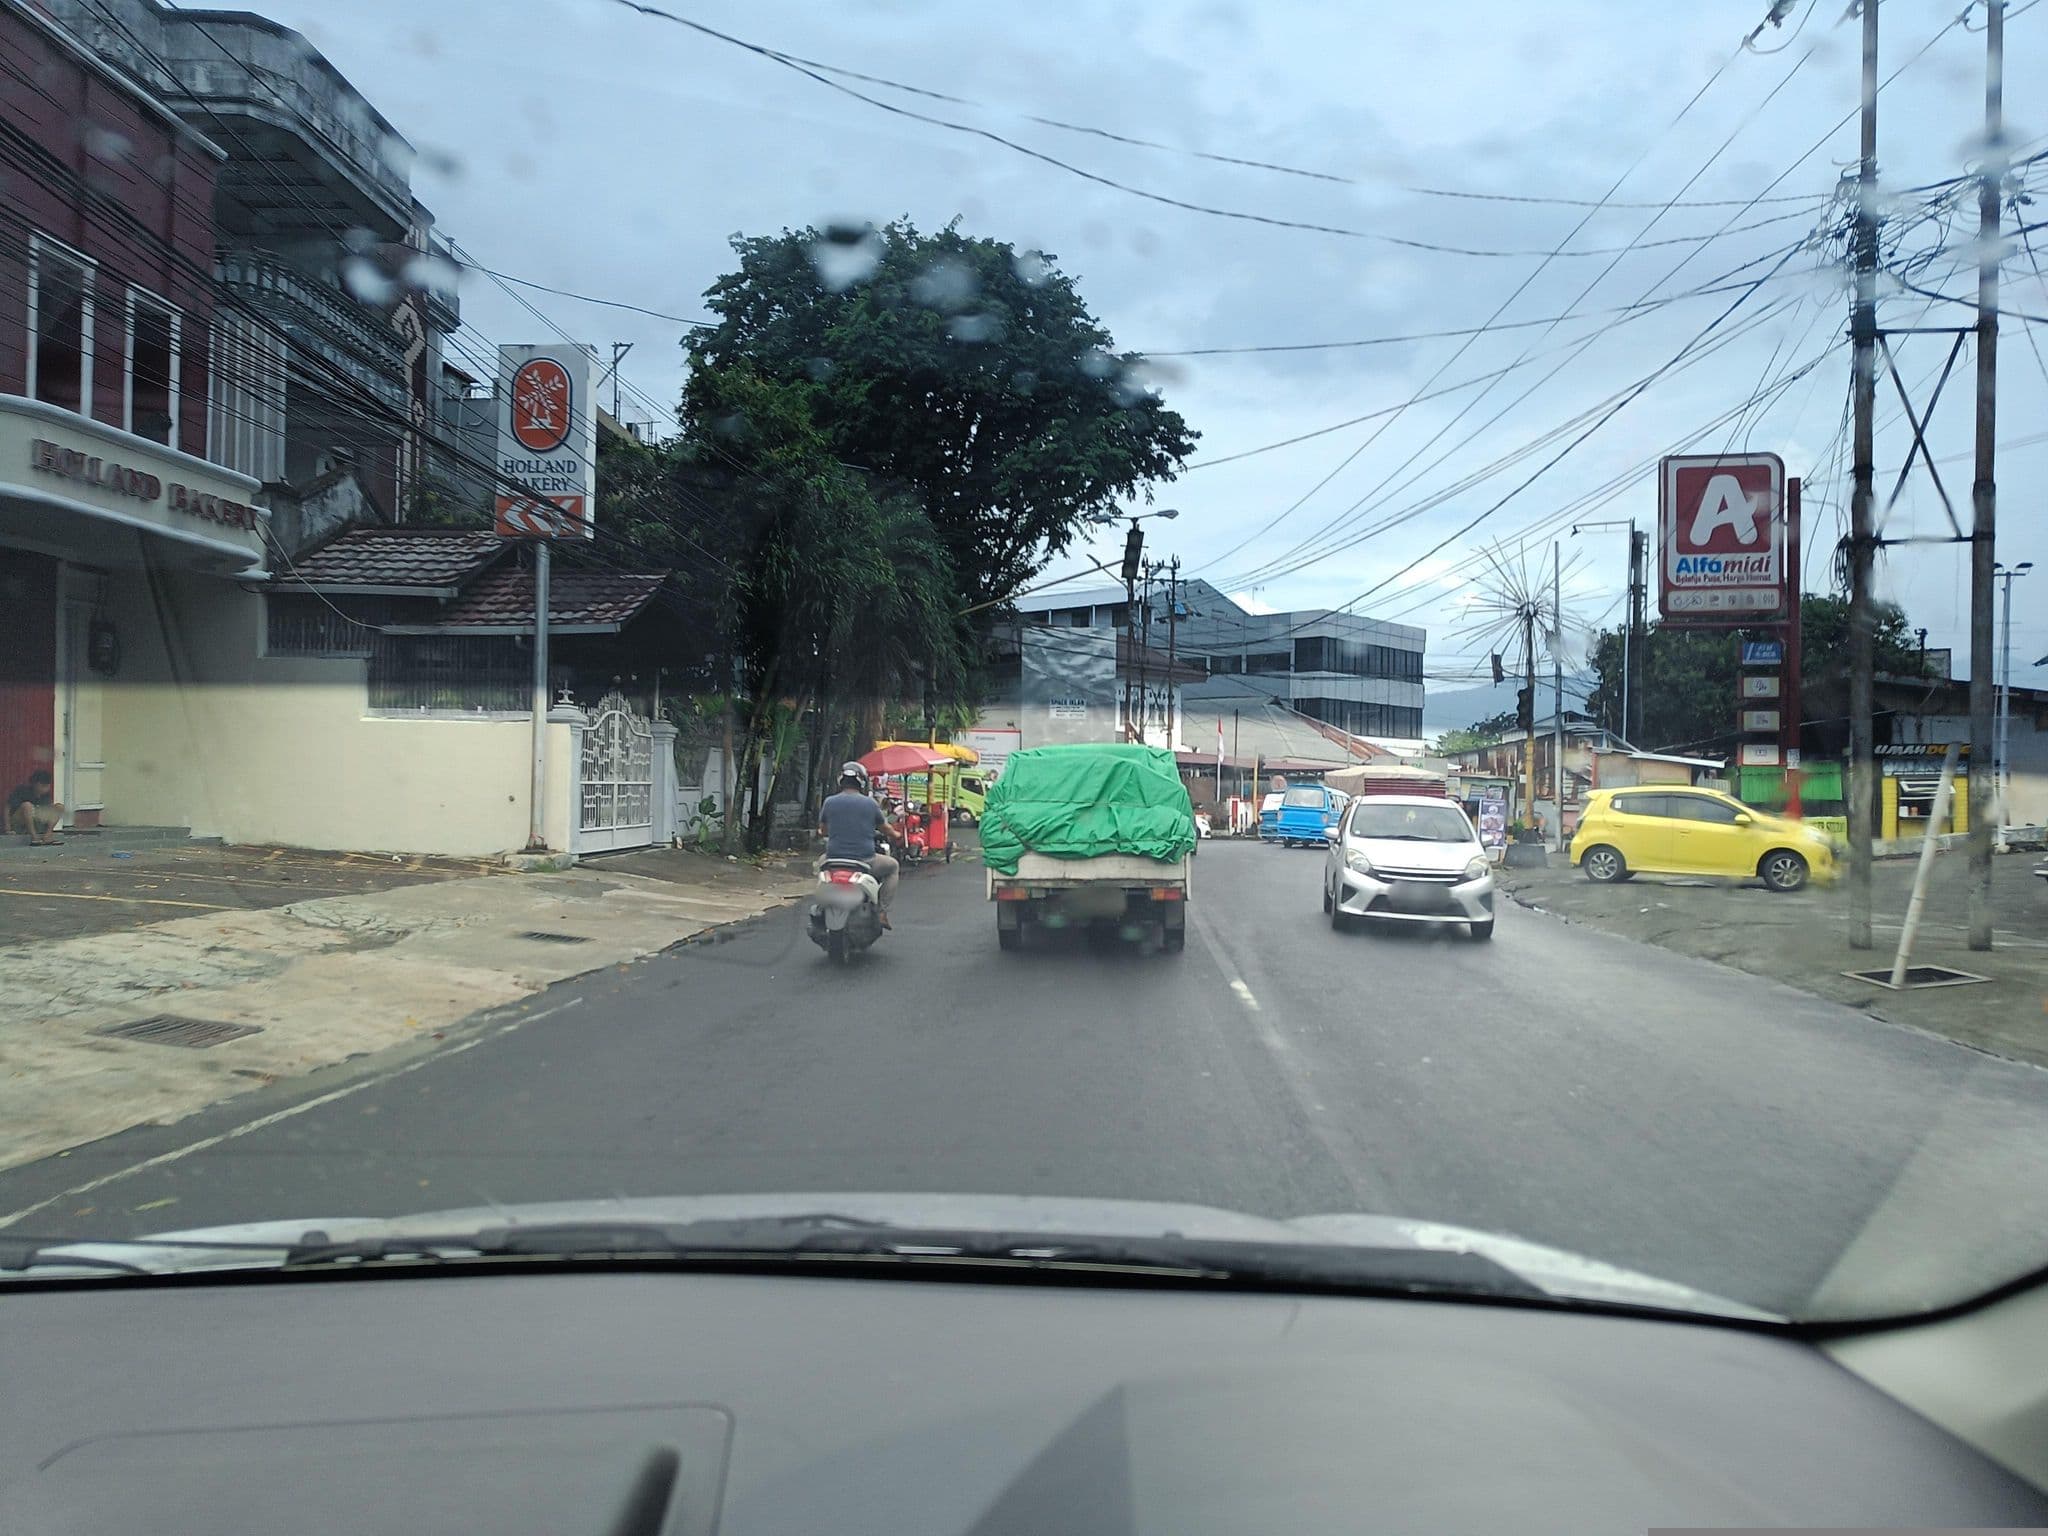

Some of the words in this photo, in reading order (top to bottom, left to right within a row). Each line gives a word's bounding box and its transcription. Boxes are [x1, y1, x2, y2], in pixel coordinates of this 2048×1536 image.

[32, 438, 161, 502] HOLLAND
[503, 459, 578, 474] HOLLAND
[507, 477, 568, 492] AKERY
[1676, 555, 1772, 575] Alfamidi
